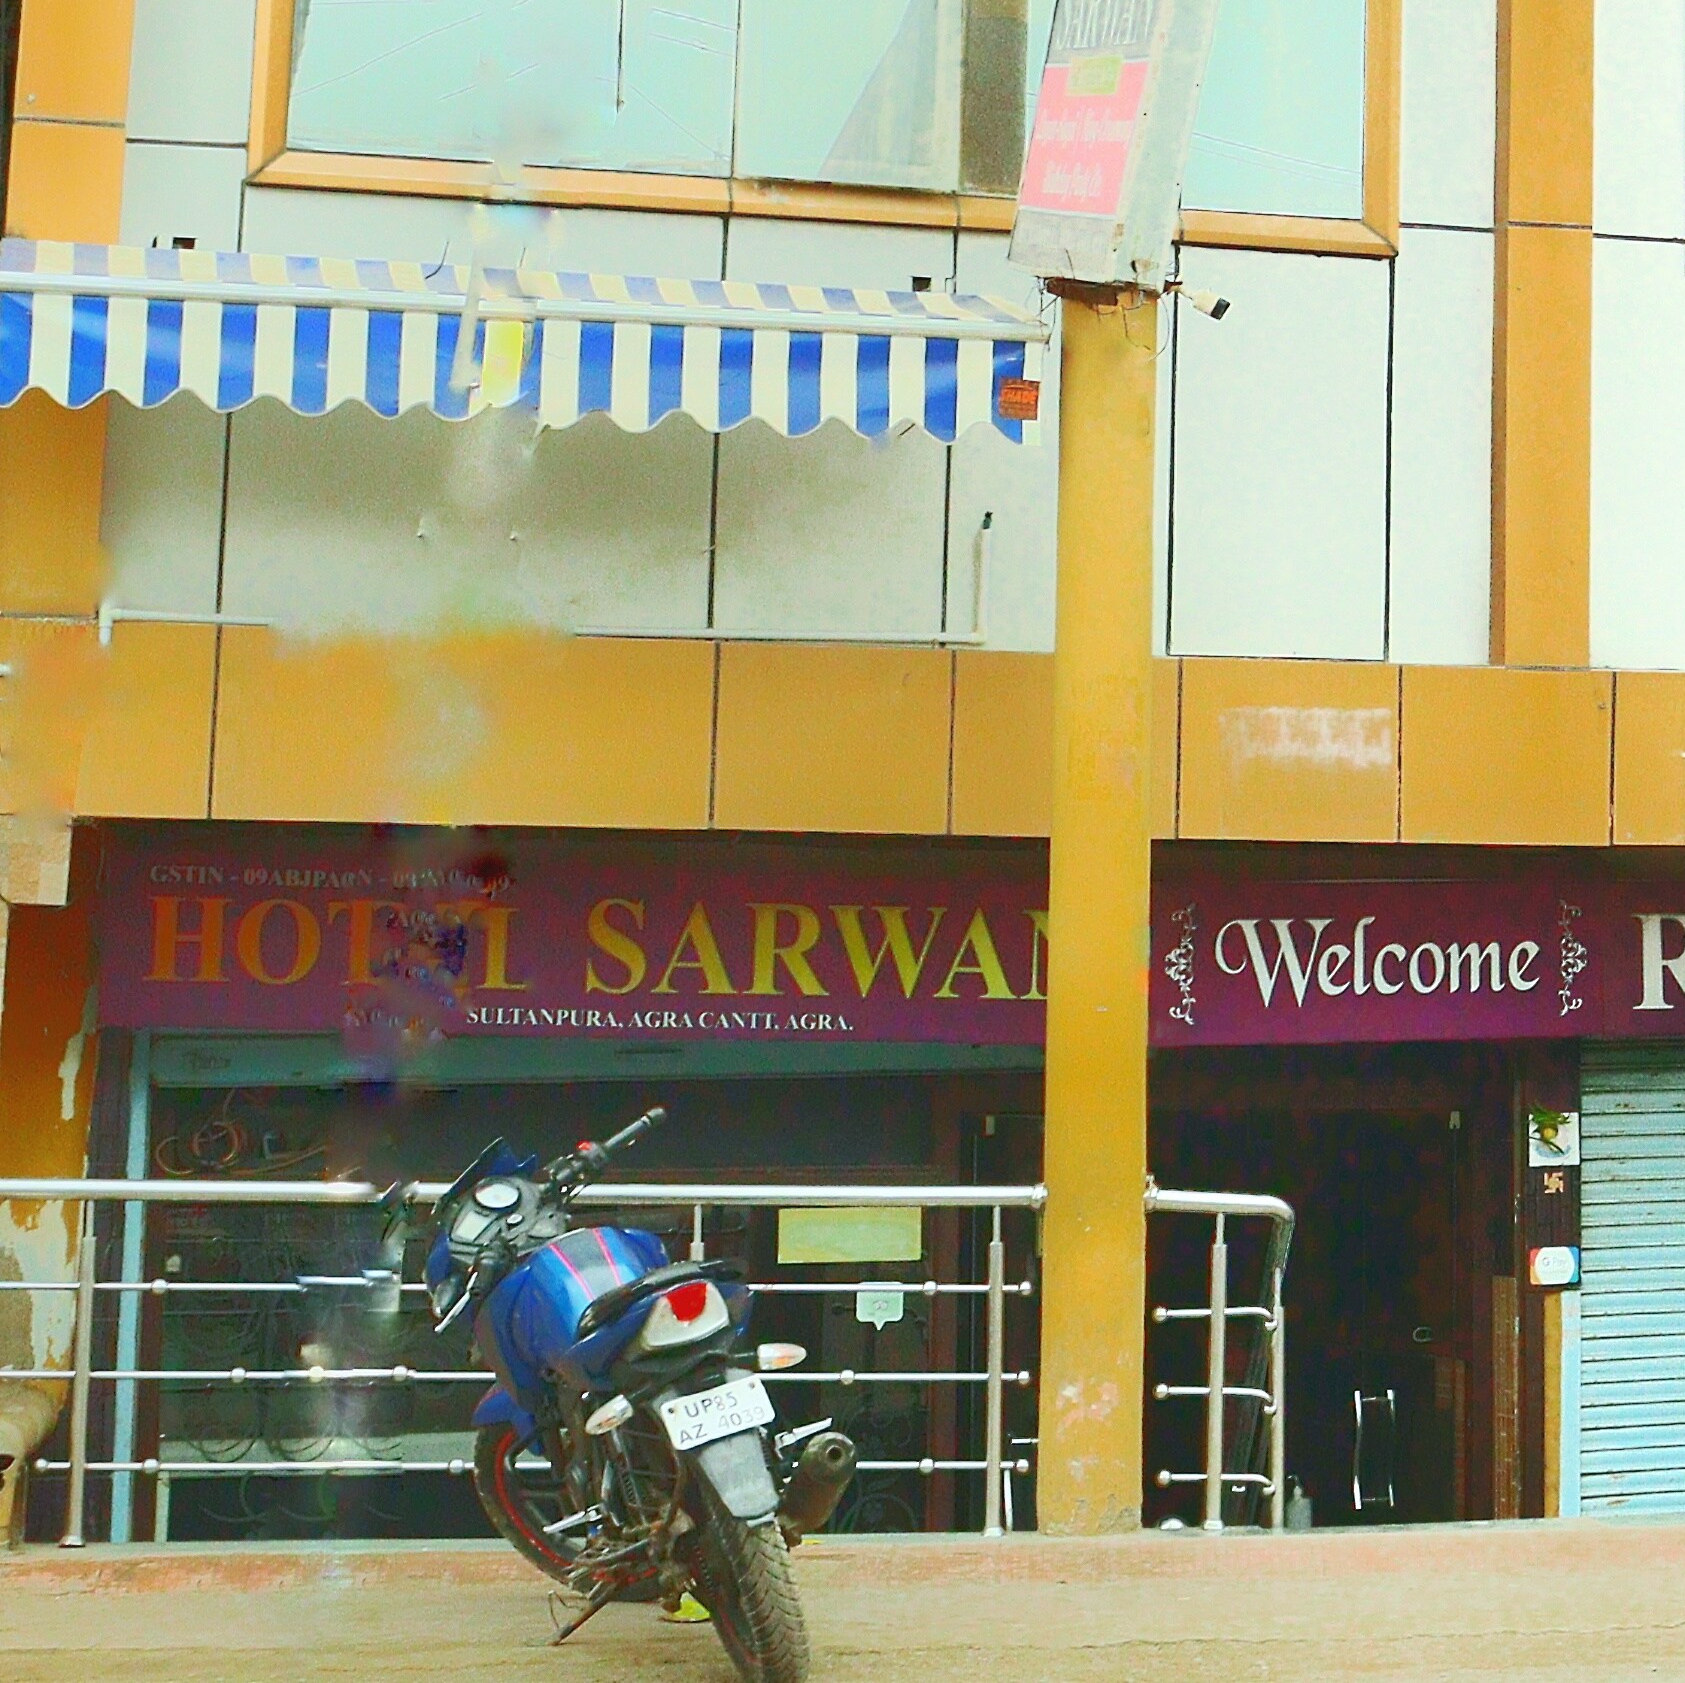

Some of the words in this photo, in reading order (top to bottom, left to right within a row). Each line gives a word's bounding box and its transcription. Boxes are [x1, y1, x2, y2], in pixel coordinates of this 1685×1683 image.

[150, 864, 226, 885] GSTIN
[1214, 916, 1541, 1008] Welcome
[466, 1006, 624, 1028] SULTANPURA,
[628, 1010, 694, 1028] AGRA
[684, 1391, 738, 1418] UP85
[679, 1423, 708, 1444] AZ
[718, 1405, 766, 1430] 4039
